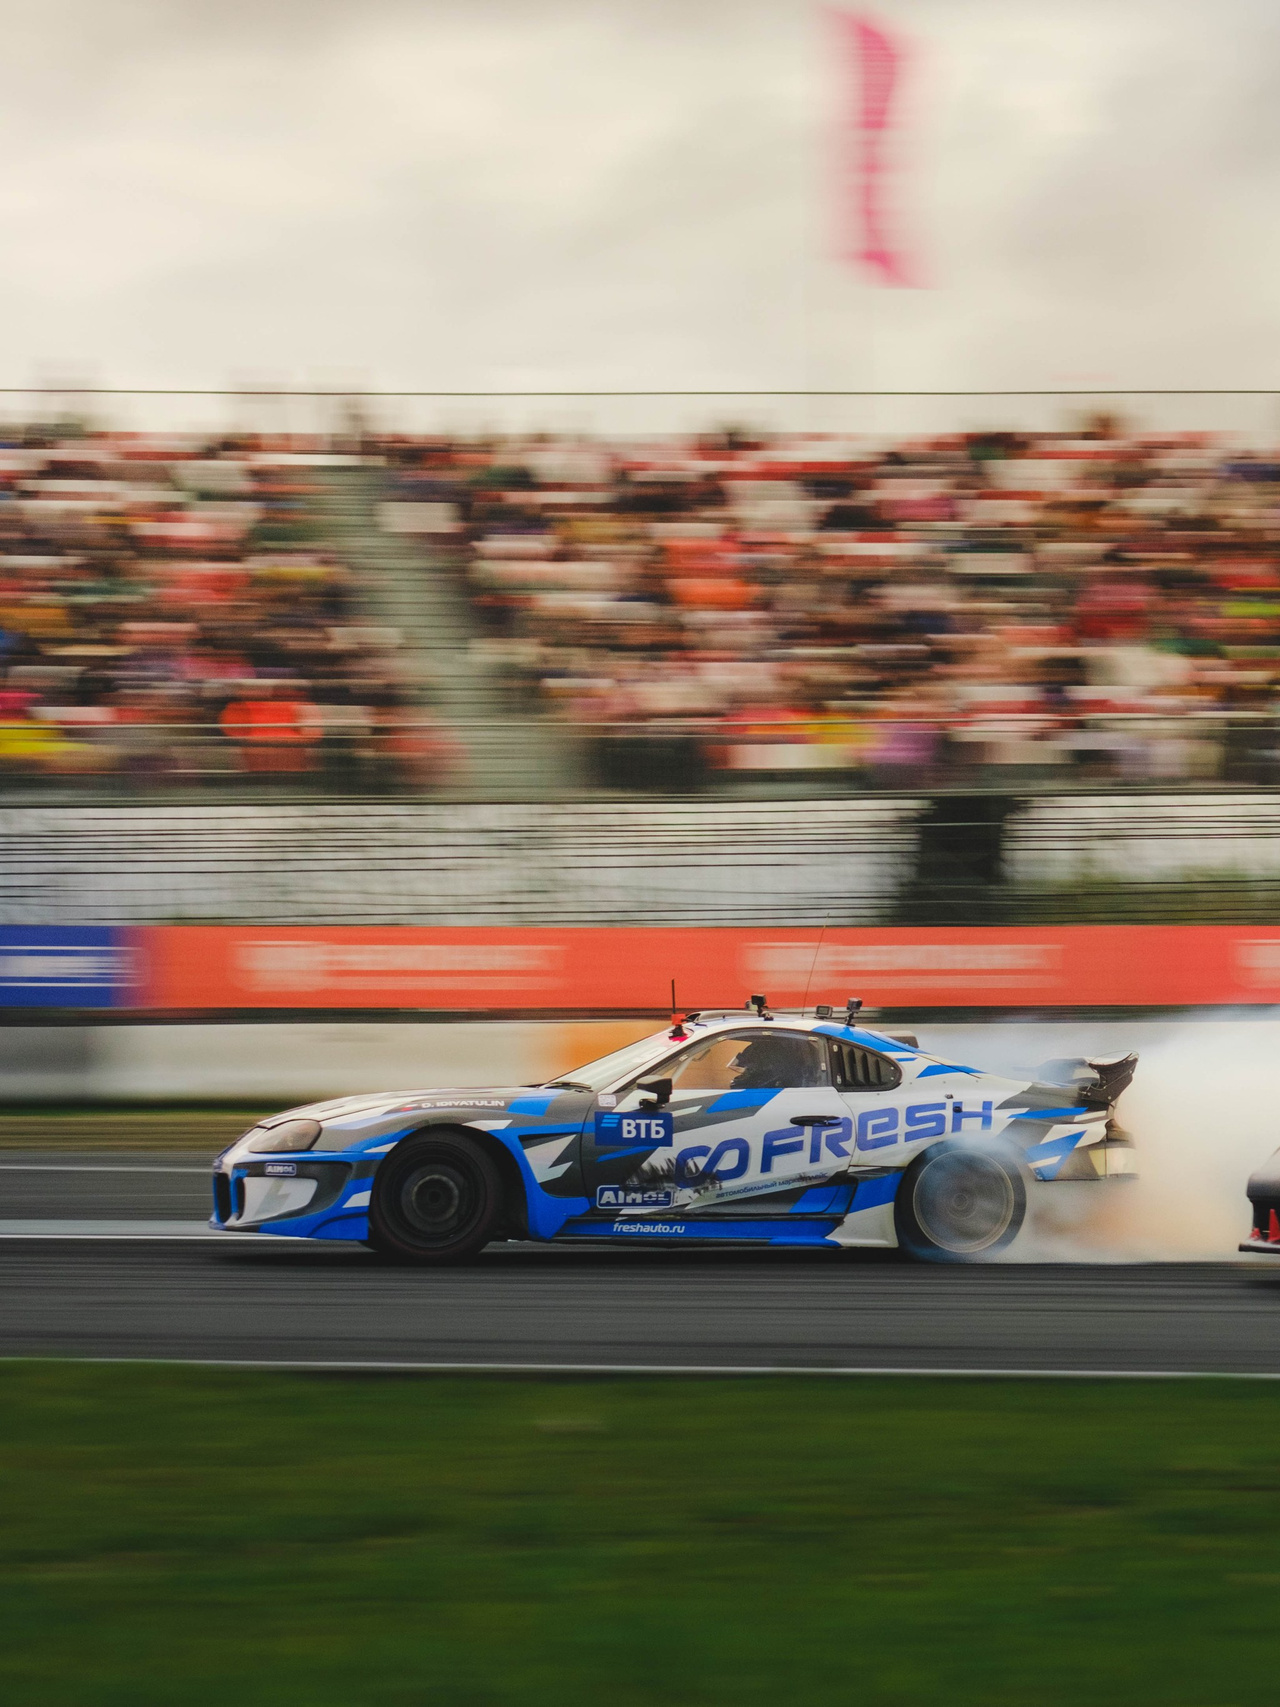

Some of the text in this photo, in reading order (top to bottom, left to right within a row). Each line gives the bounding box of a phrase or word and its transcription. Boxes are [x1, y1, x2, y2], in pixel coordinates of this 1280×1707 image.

[622, 1118, 665, 1138] ВТБ
[600, 1190, 669, 1204] AIMOL
[715, 1180, 777, 1199] автомобильный
[613, 1222, 685, 1234] freshauto.ru
